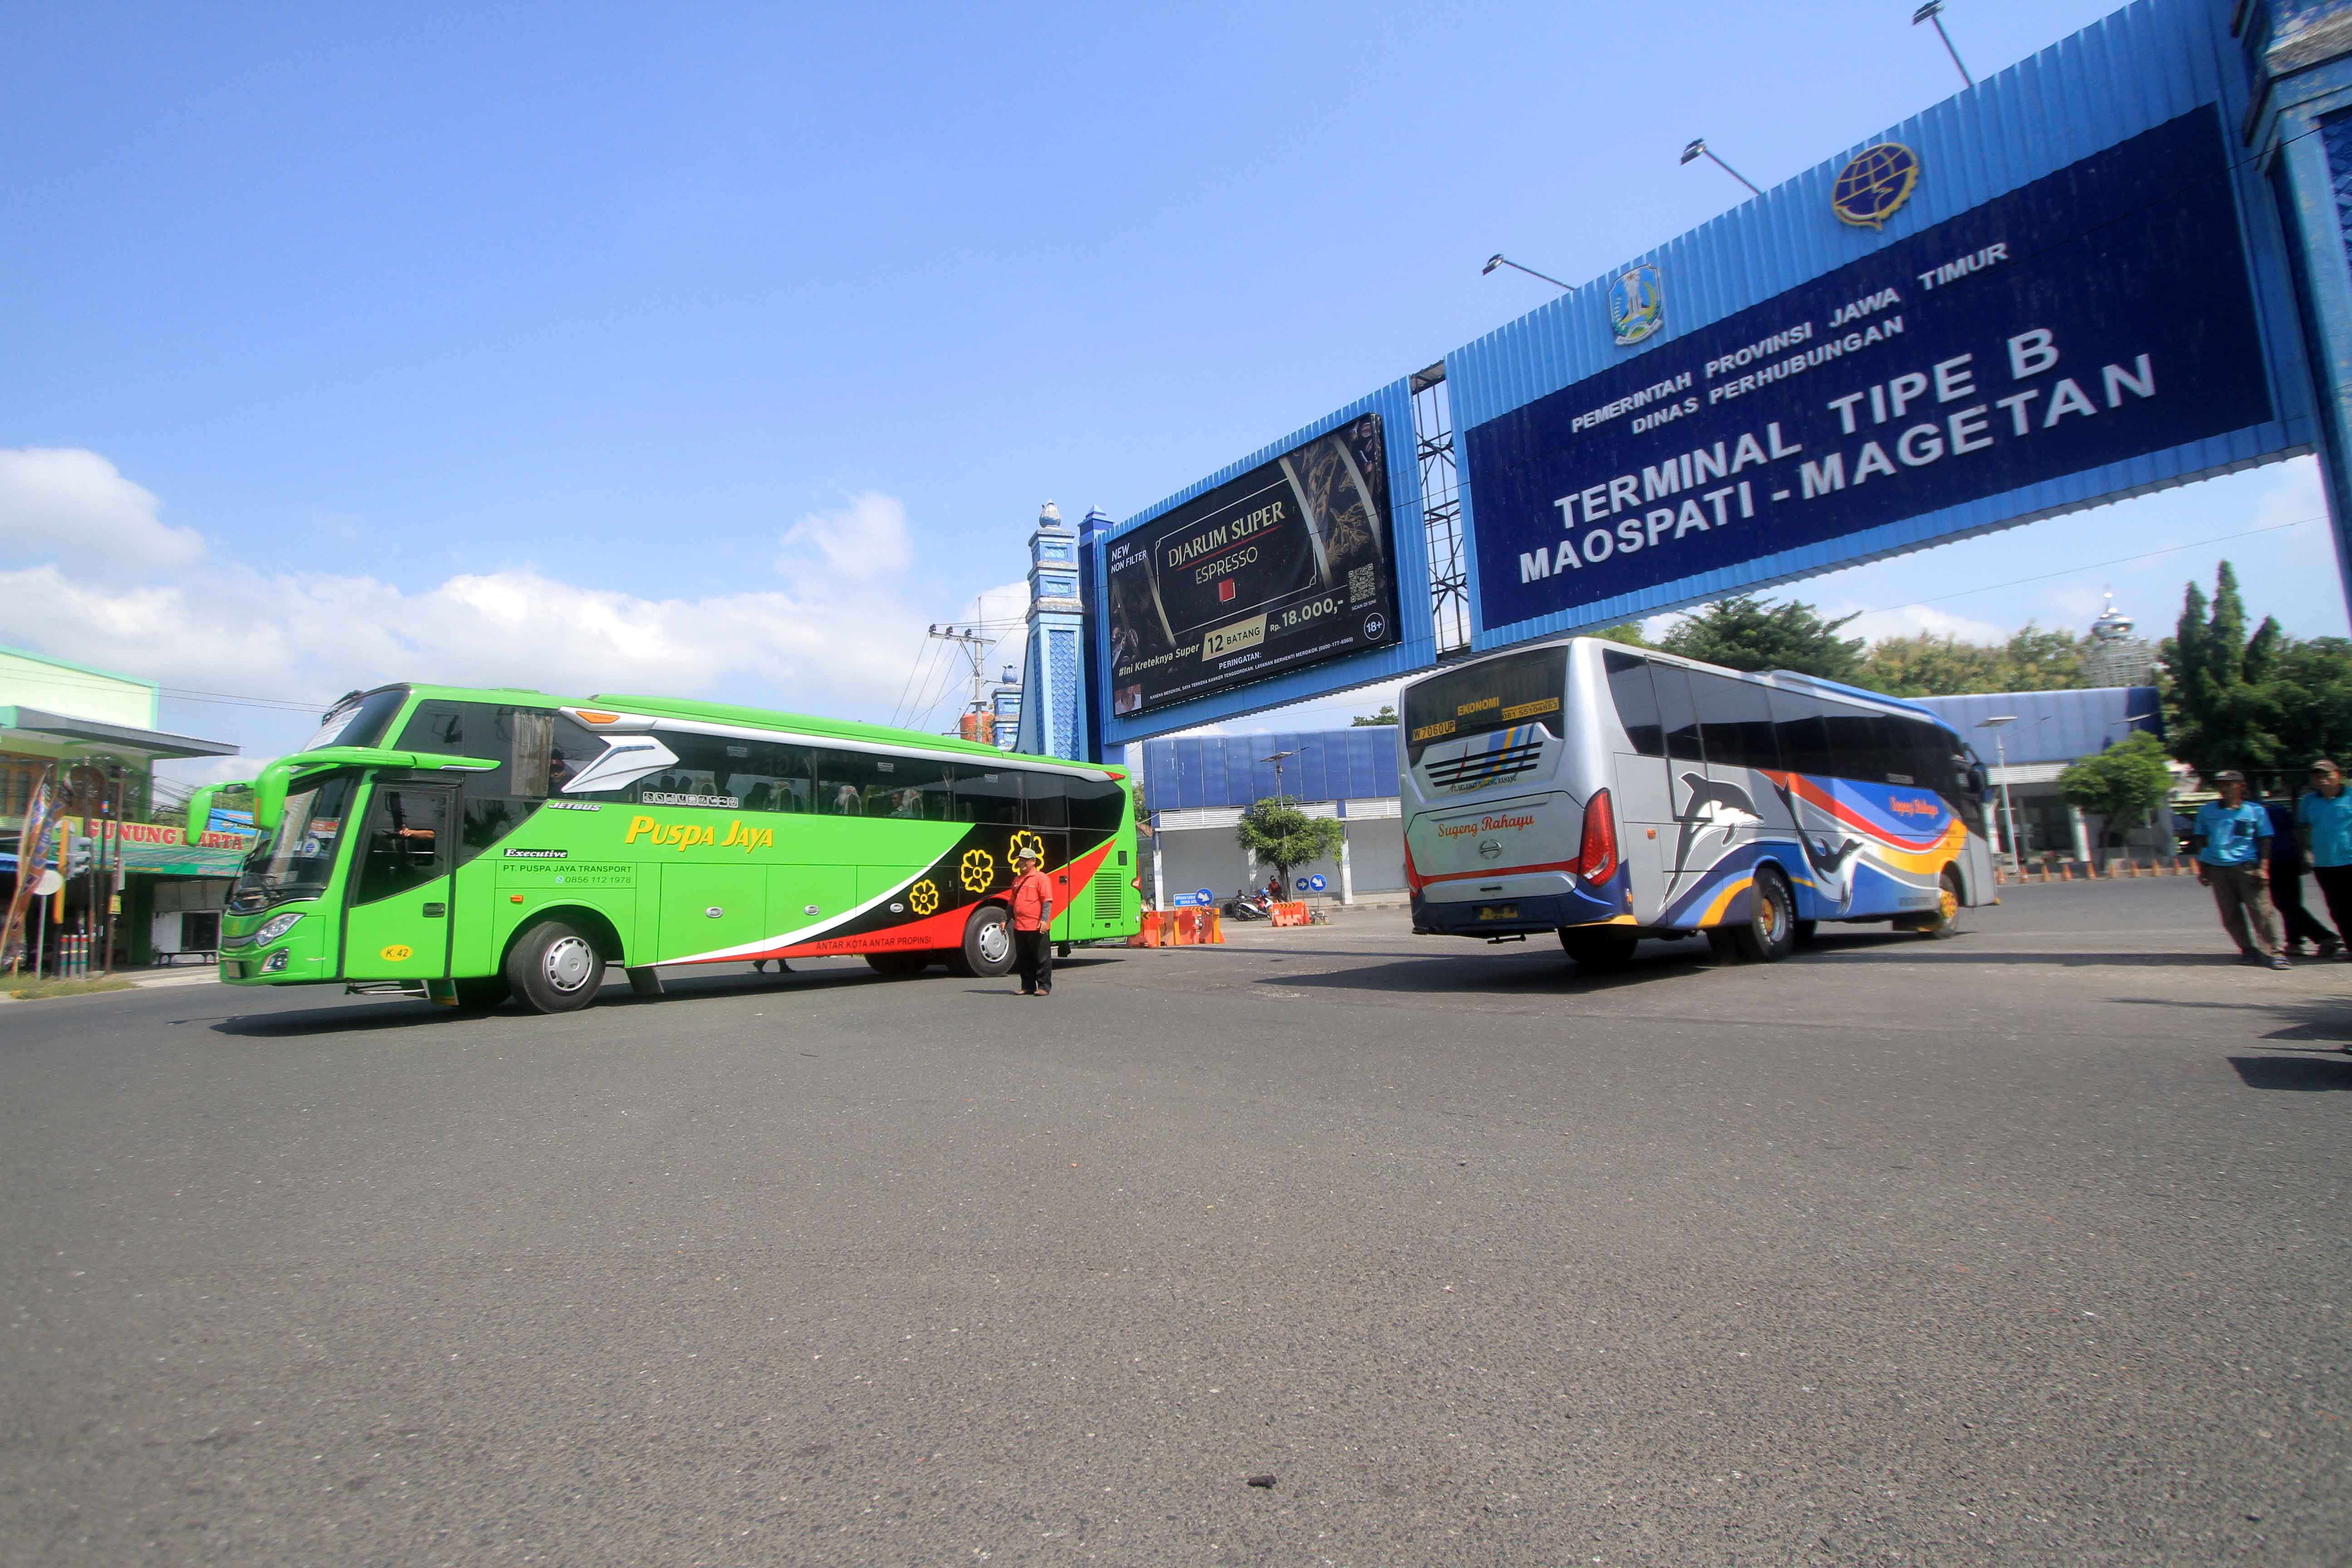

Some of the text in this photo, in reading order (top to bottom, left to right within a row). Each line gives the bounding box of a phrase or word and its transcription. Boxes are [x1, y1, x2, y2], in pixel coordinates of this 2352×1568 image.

[1571, 242, 2009, 433] PEMERINTAH PROVINSI JAWA TIMUR
[1632, 315, 1904, 434] DINAS PERHUBUNGAN
[1554, 328, 2060, 529] TERMINAL TIPE B
[1519, 480, 1754, 584] MAOSPATI
[1799, 353, 2156, 500] MAGETAN
[1168, 501, 1285, 567] DJARUM SUPER
[1111, 550, 1147, 573] NON FILTER
[1112, 543, 1130, 562] NEW
[1196, 546, 1258, 585] ESPRESSO
[1270, 598, 1343, 632] Rp. 18.000,-
[1366, 621, 1382, 633] 18+
[1207, 627, 1260, 654] 12 BATANG
[1119, 643, 1200, 676] #Ini Kreteknya Super
[1191, 680, 1208, 688] TERKENA
[1208, 675, 1223, 683] KANKER
[1255, 661, 1273, 670] LAYANAN
[1274, 655, 1295, 664] BERHENTI
[1295, 647, 1318, 657] MEROKOK
[1219, 651, 1262, 670] PERINGATAN:
[1457, 697, 1499, 716] EKONOMI
[548, 802, 602, 811] JETBUS
[85, 821, 176, 844] GUNUNG
[1438, 814, 1535, 839] Sugeng Rahayu
[504, 849, 567, 858] Executive
[397, 949, 408, 957] 42
[816, 936, 931, 950] ANTAR KOTA ANTAR PROPINSI
